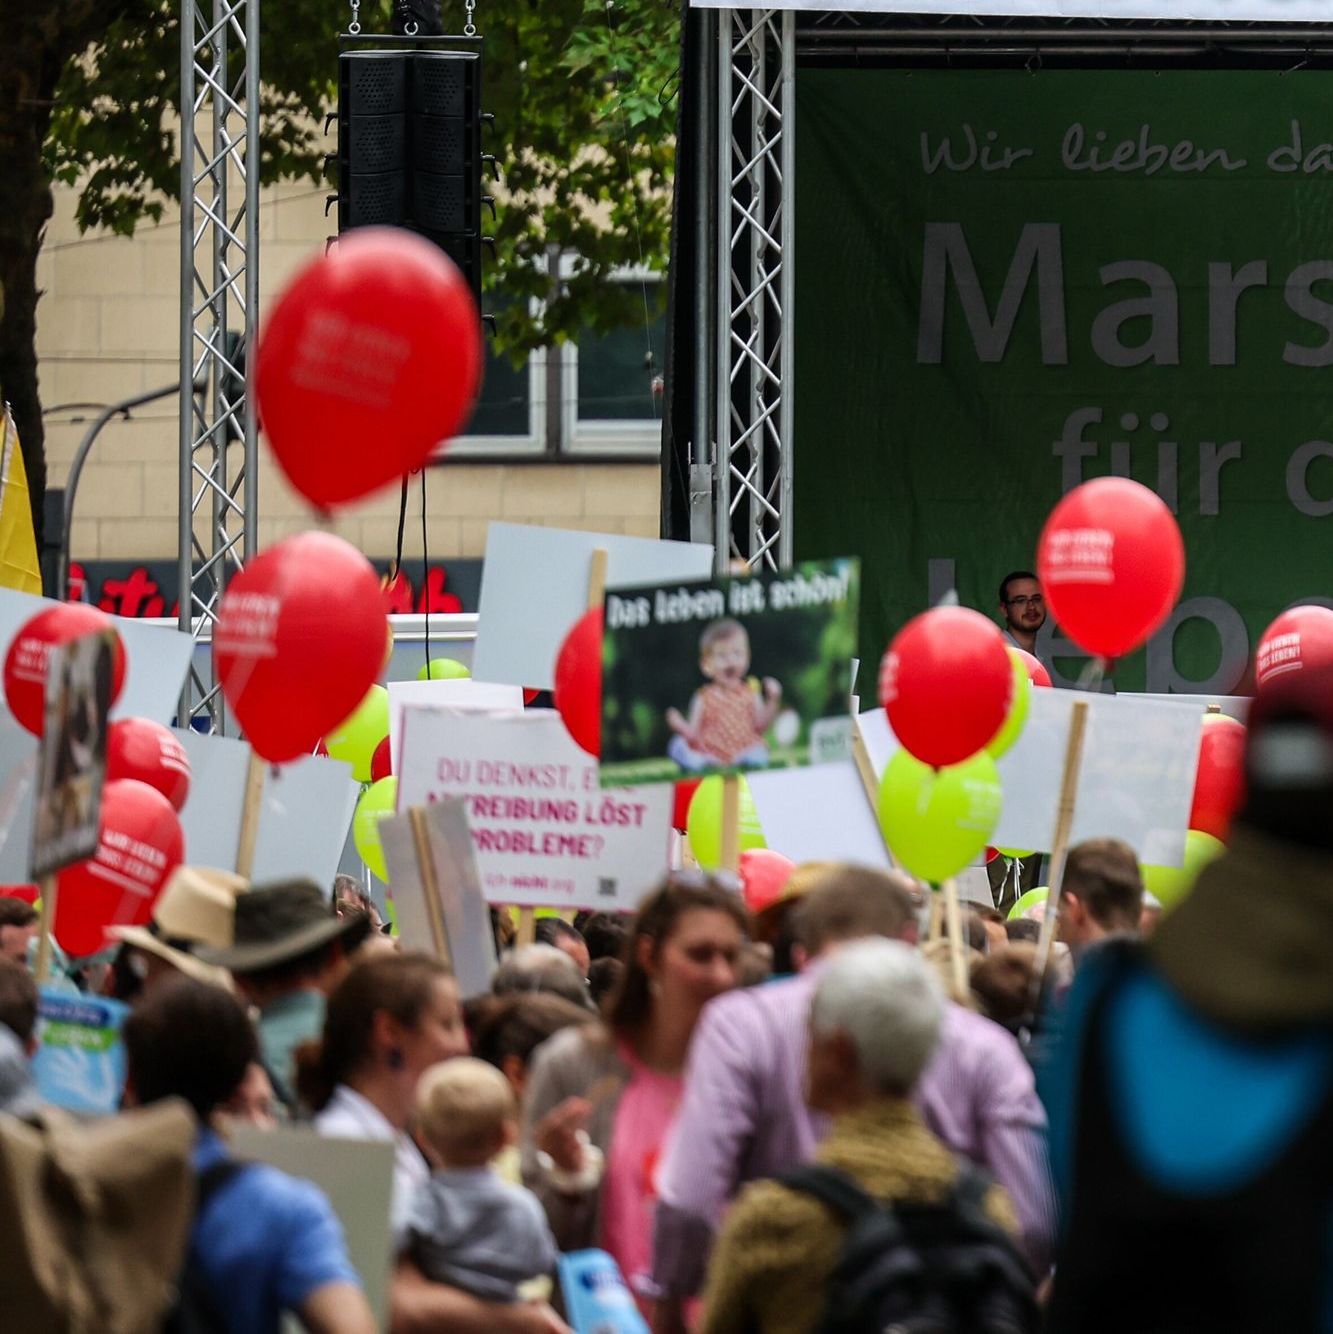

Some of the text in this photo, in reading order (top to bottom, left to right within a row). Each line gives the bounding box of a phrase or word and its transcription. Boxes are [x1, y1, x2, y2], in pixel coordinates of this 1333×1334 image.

[919, 122, 1036, 175] Wir
[1061, 121, 1247, 175] lieben
[1052, 406, 1243, 517] für
[608, 568, 850, 629] Das Leben ist schön!
[437, 757, 470, 784] DU
[476, 760, 576, 791] DENKST,
[585, 797, 648, 828] LÖST
